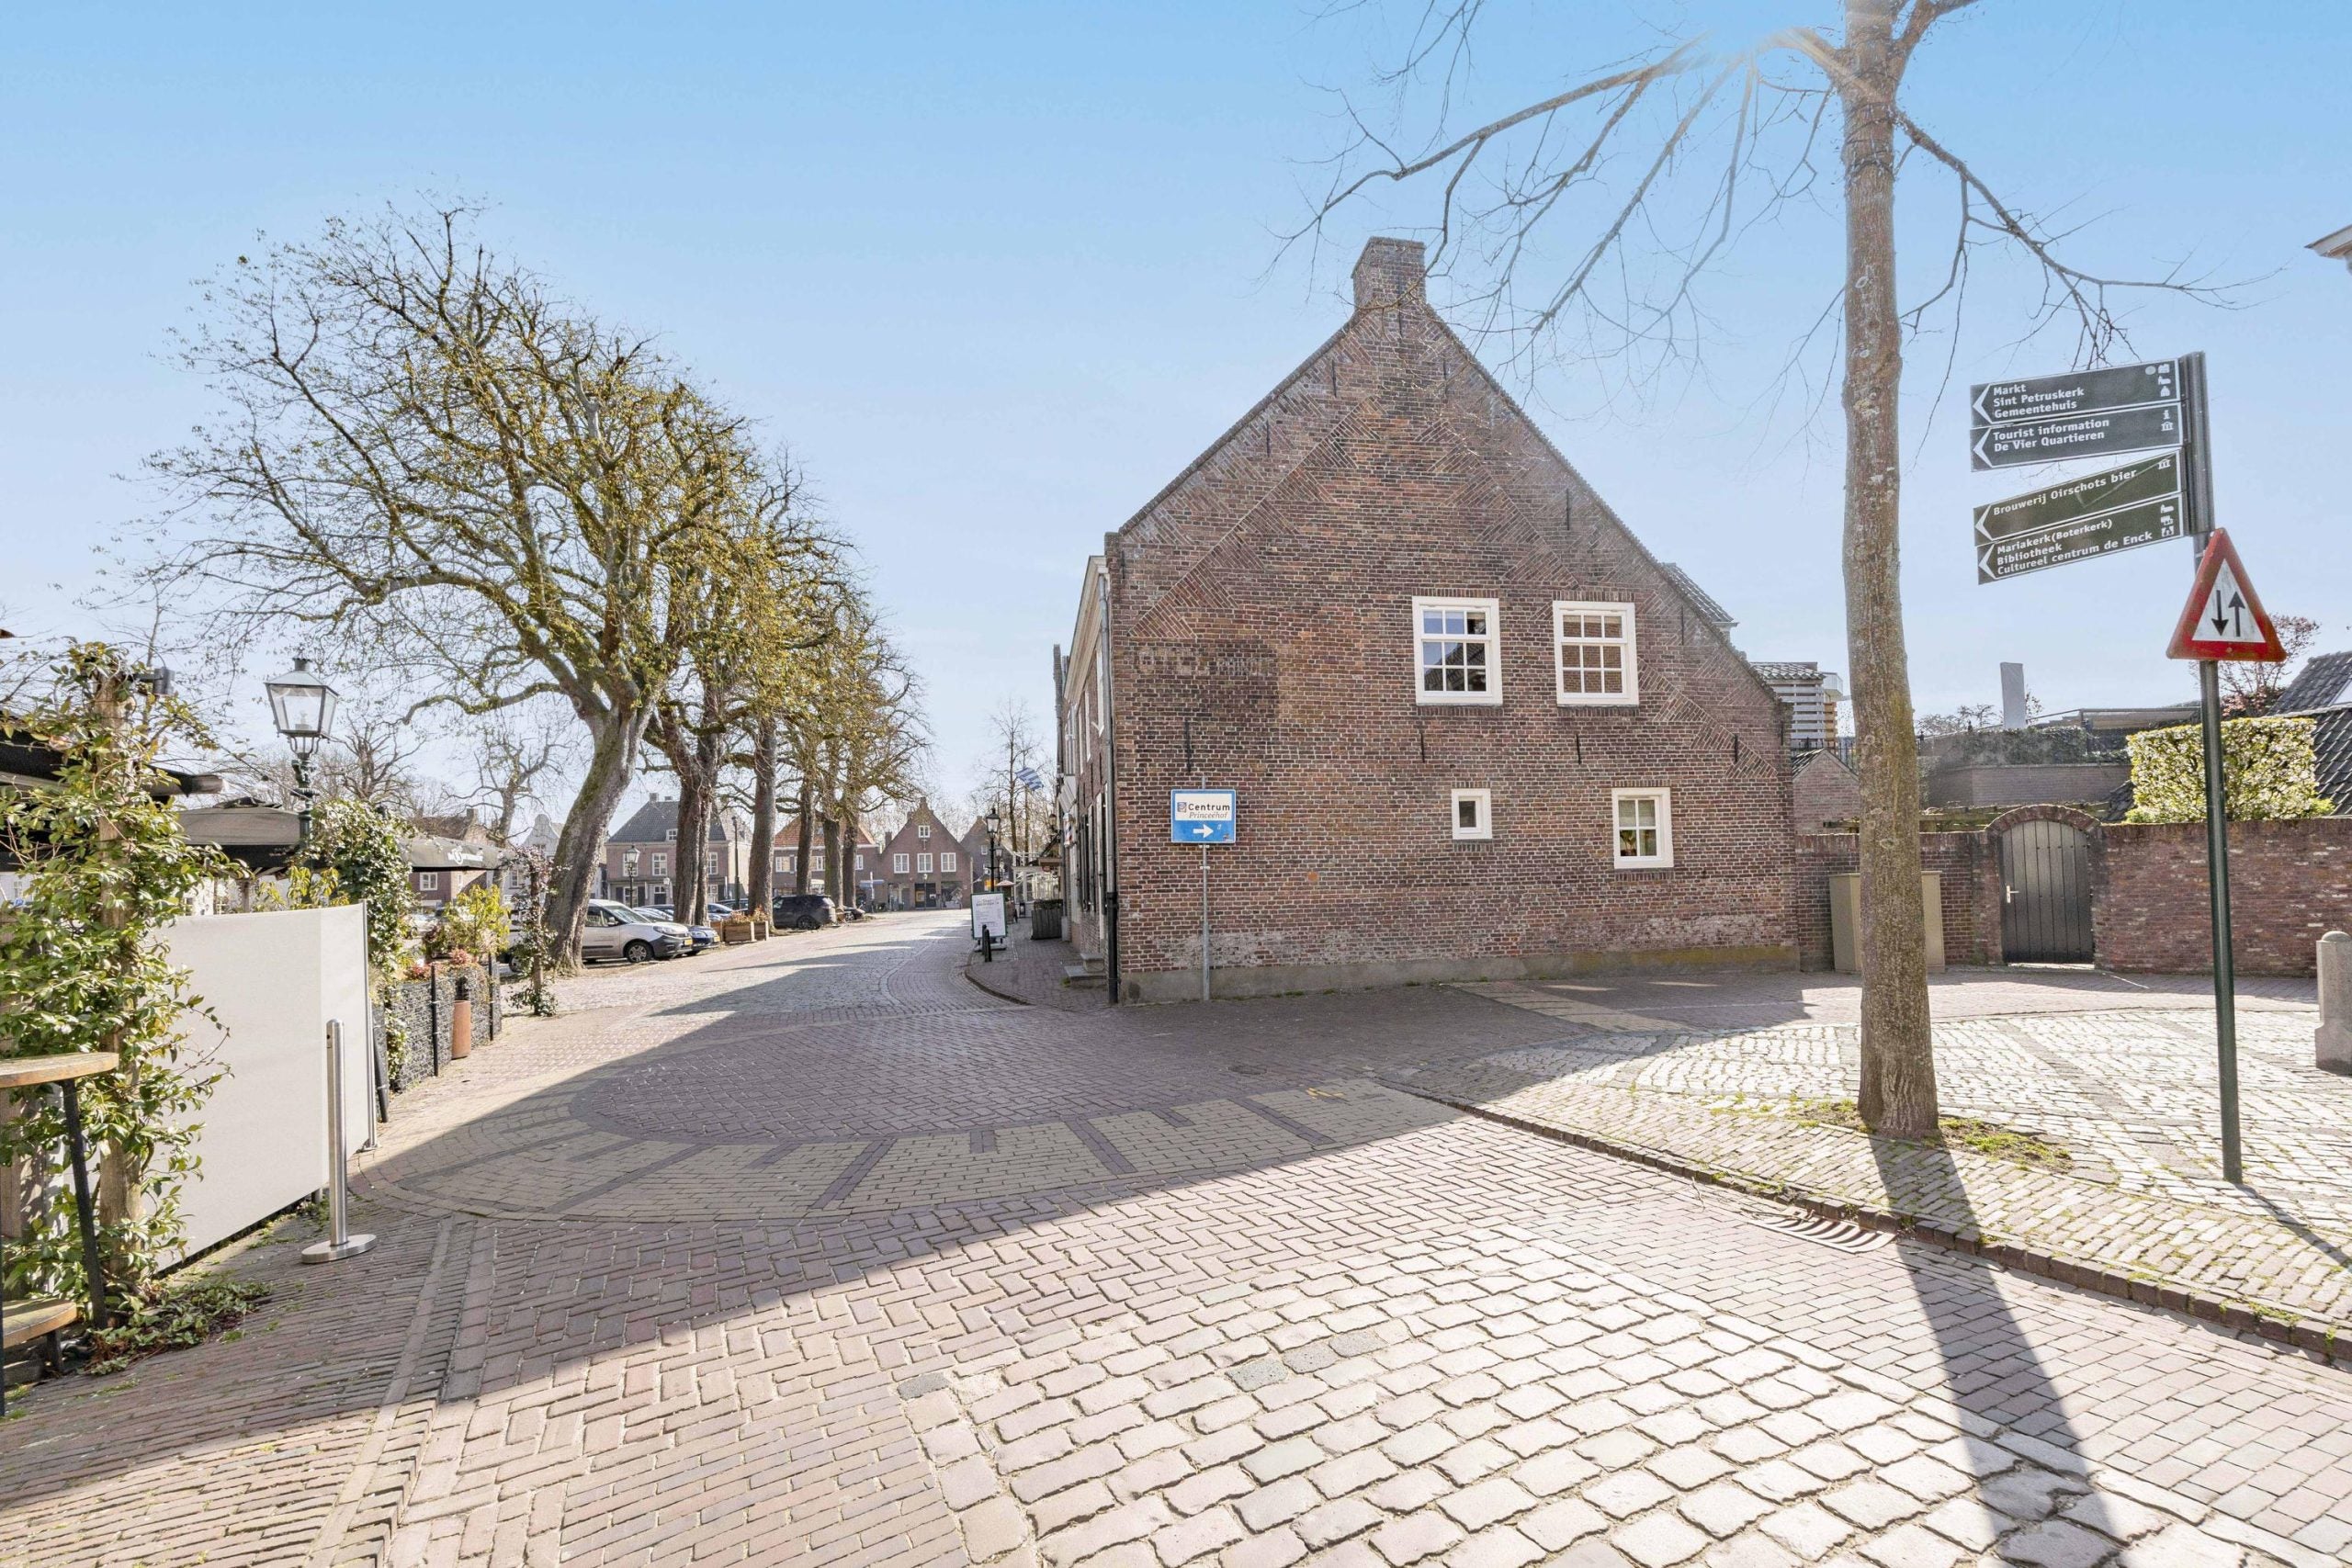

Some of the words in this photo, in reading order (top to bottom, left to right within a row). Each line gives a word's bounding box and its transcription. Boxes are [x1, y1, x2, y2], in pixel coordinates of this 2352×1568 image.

[1993, 384, 2027, 396] Markt
[1993, 397, 2018, 407] Sint
[2020, 387, 2085, 404] Petruskerk
[1994, 400, 2077, 418] Gemeentehuis
[1993, 427, 2035, 441] Tourist
[2037, 419, 2110, 435] information
[1994, 443, 2009, 452] De
[2012, 438, 2038, 450] Vier
[2041, 431, 2105, 446] Quartieren
[1993, 493, 2048, 516] Brouwerij
[2050, 478, 2108, 500] Oirschots
[2110, 468, 2138, 484] bier
[1996, 543, 2064, 566] Bibliotheek
[1997, 556, 2049, 576] Cultureel
[2051, 545, 2100, 563] centrum
[2103, 539, 2120, 551] de
[2122, 531, 2154, 546] Enck
[1188, 803, 1230, 811] Centrum
